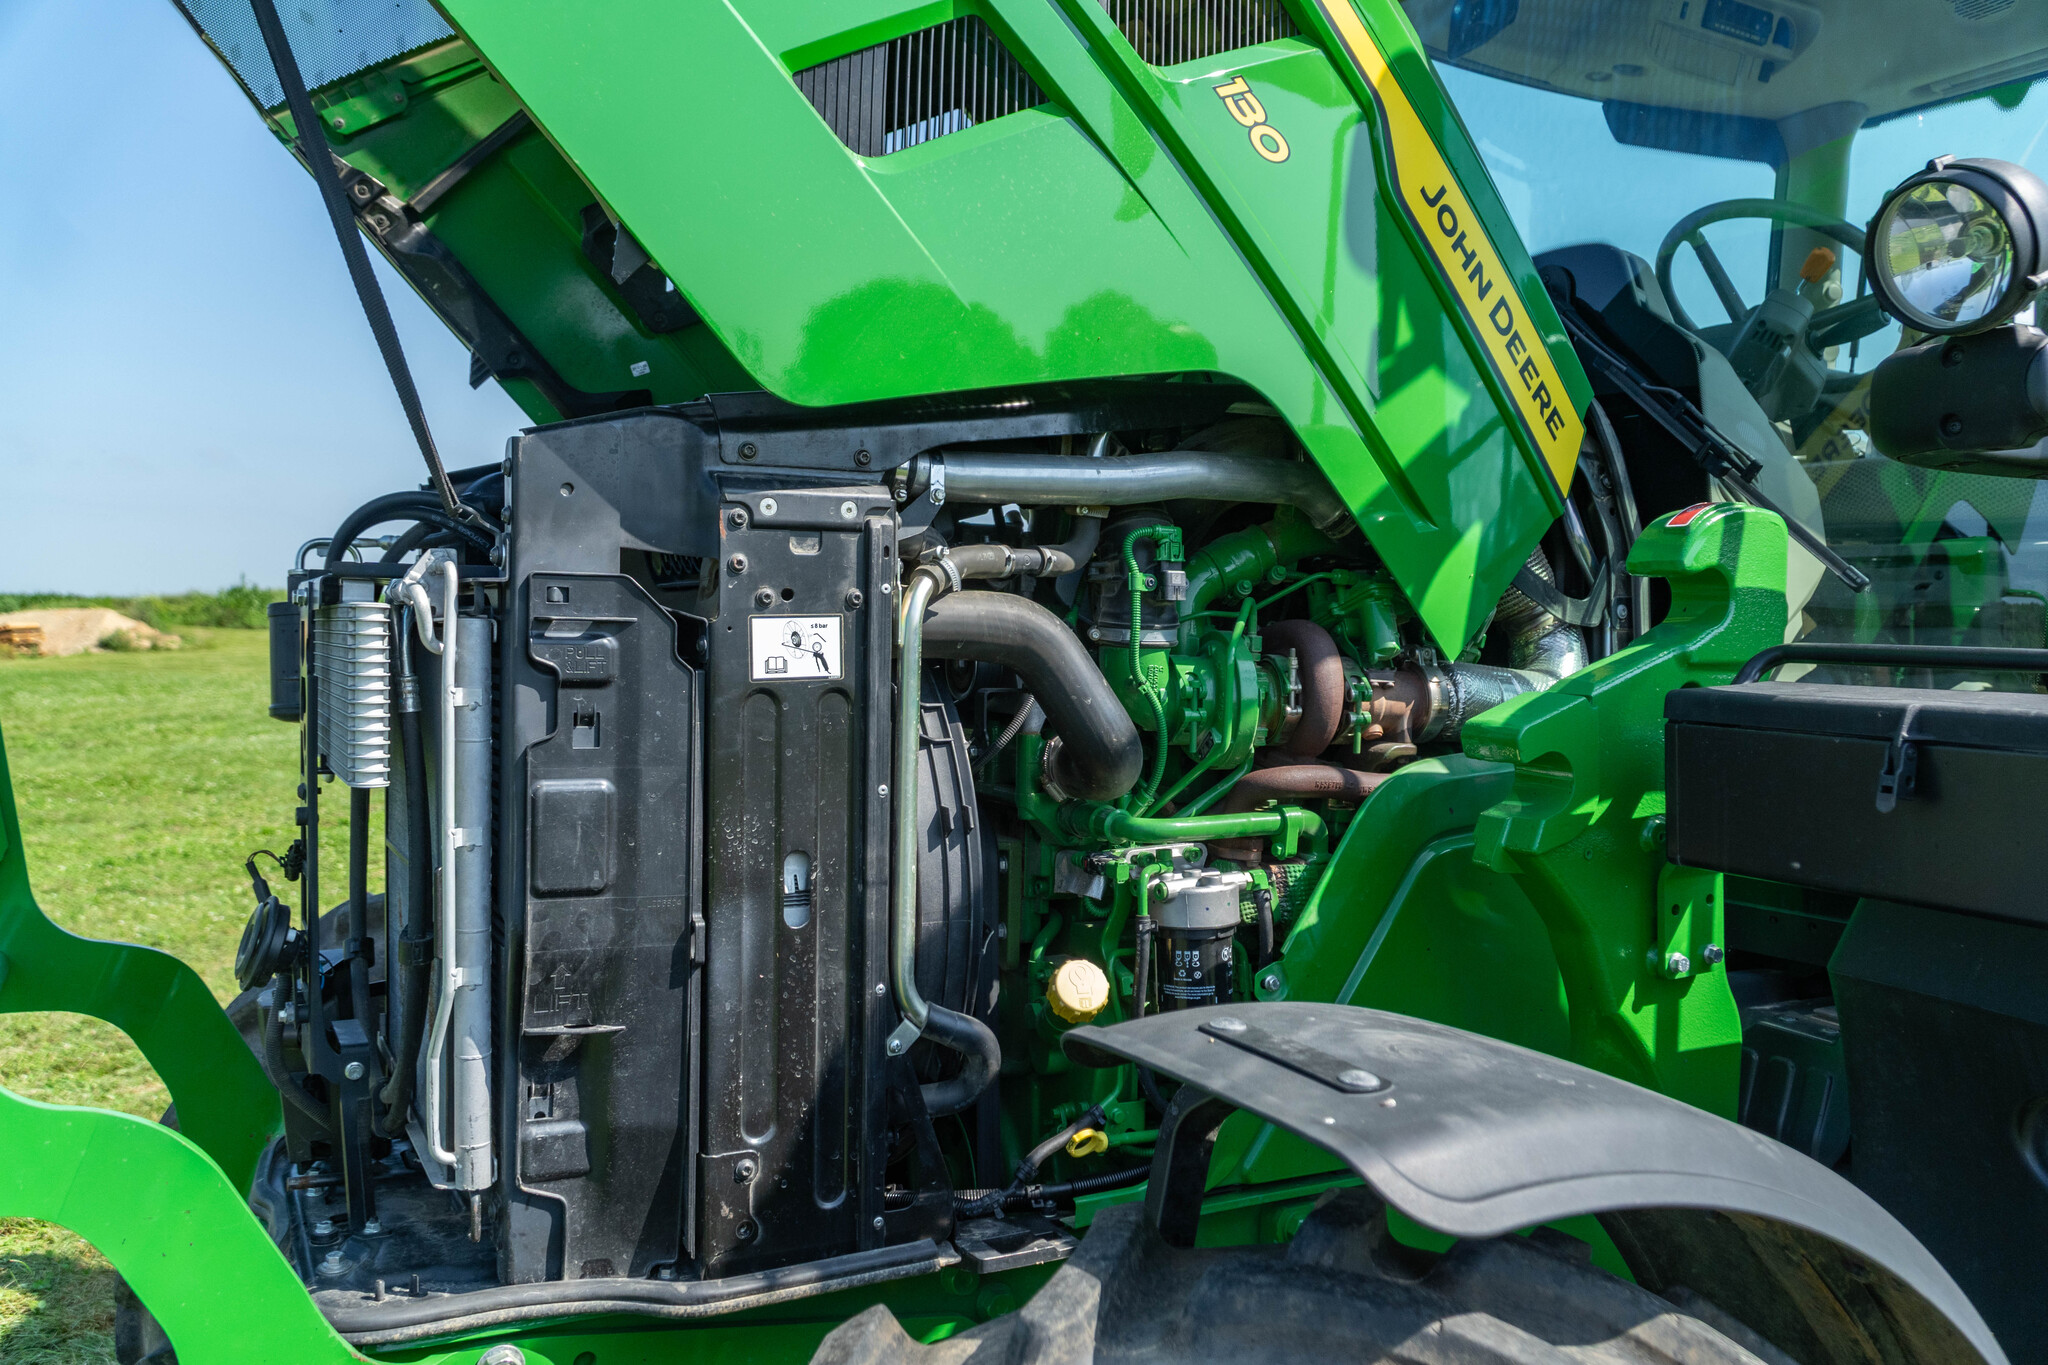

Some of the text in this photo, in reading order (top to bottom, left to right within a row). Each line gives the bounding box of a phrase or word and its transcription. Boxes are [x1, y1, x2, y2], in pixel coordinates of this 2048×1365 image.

[1212, 75, 1291, 163] 130
[1420, 185, 1566, 442] JOHN DEERE
[565, 646, 605, 660] PULL
[565, 660, 607, 674] &LIFT
[533, 993, 588, 1013] LIFT
